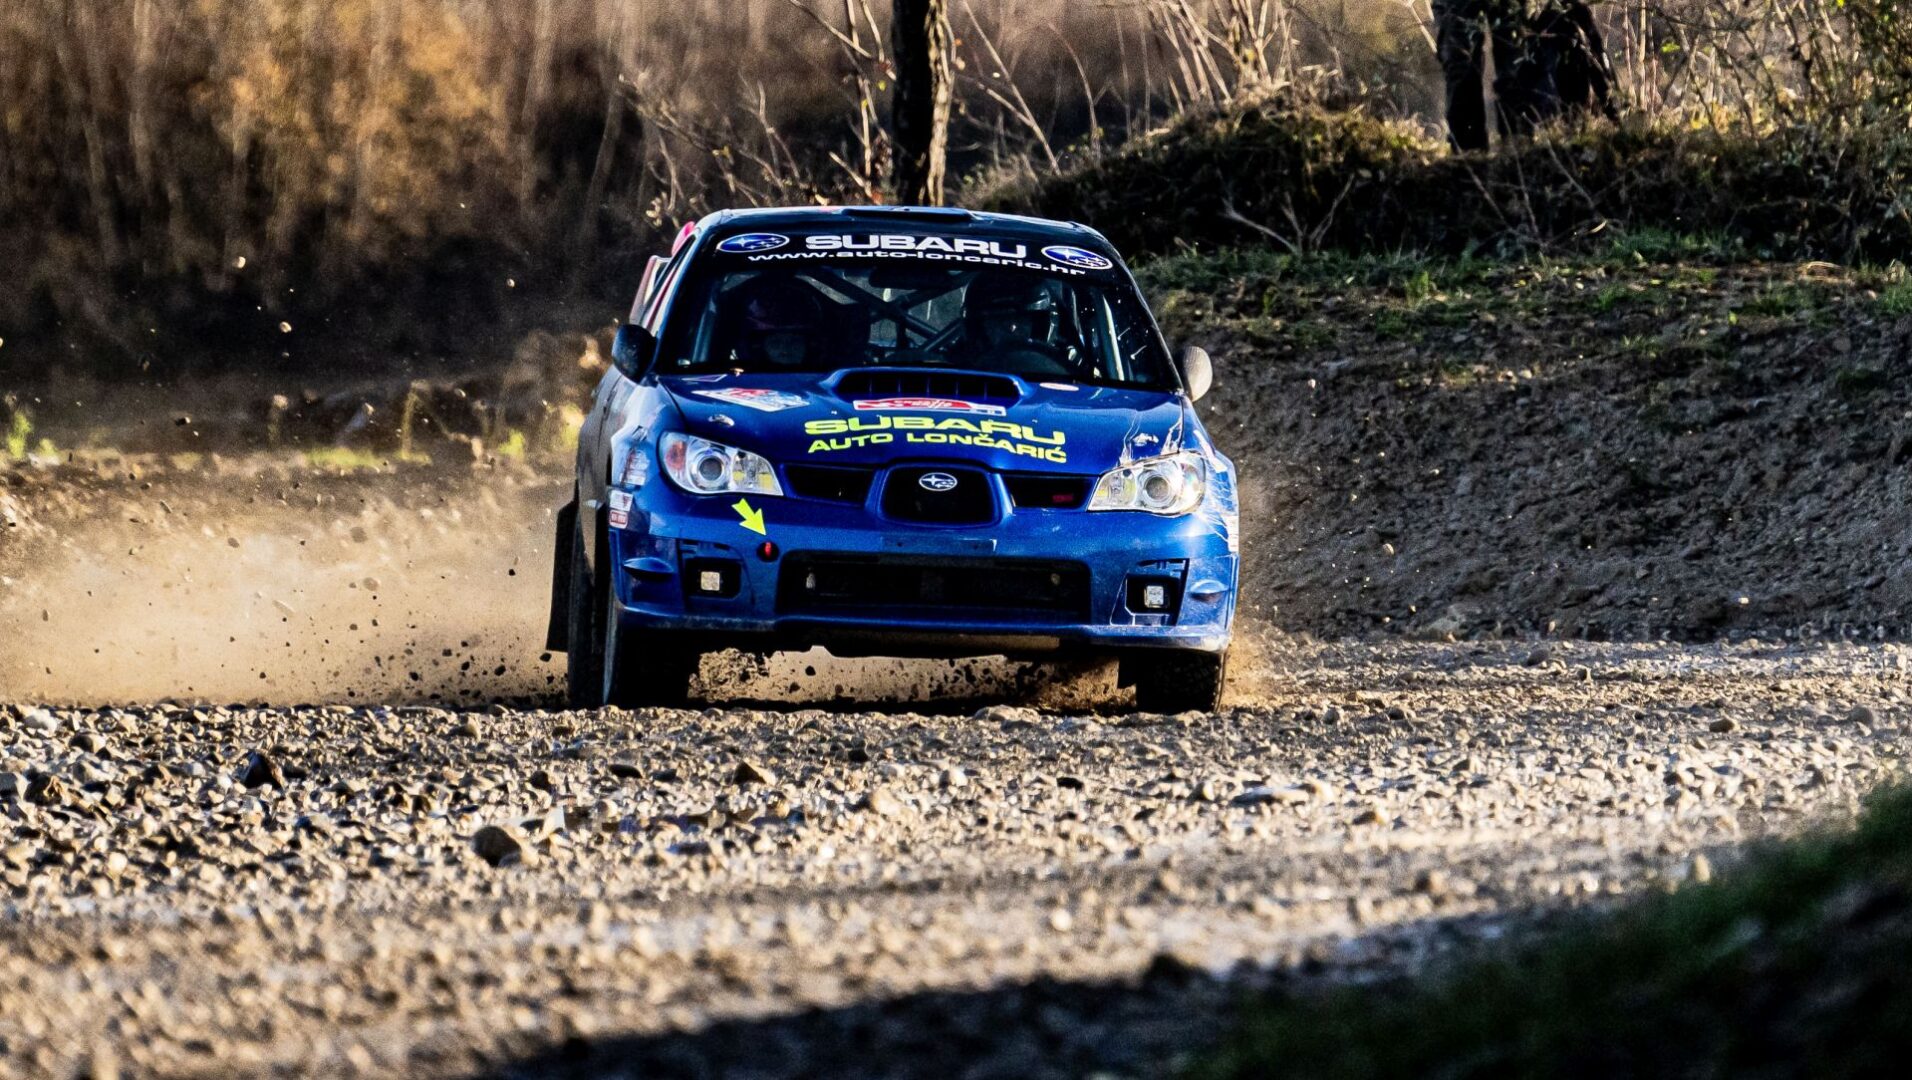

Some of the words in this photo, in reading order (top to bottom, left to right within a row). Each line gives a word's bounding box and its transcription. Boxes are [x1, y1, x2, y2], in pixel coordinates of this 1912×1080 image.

[805, 235, 1026, 258] SUBARU
[748, 250, 1085, 275] www.auto-loncaric.hr
[804, 416, 1066, 445] SUBARU
[808, 433, 893, 453] AUTO
[906, 432, 1067, 463] LONČARIĆ
